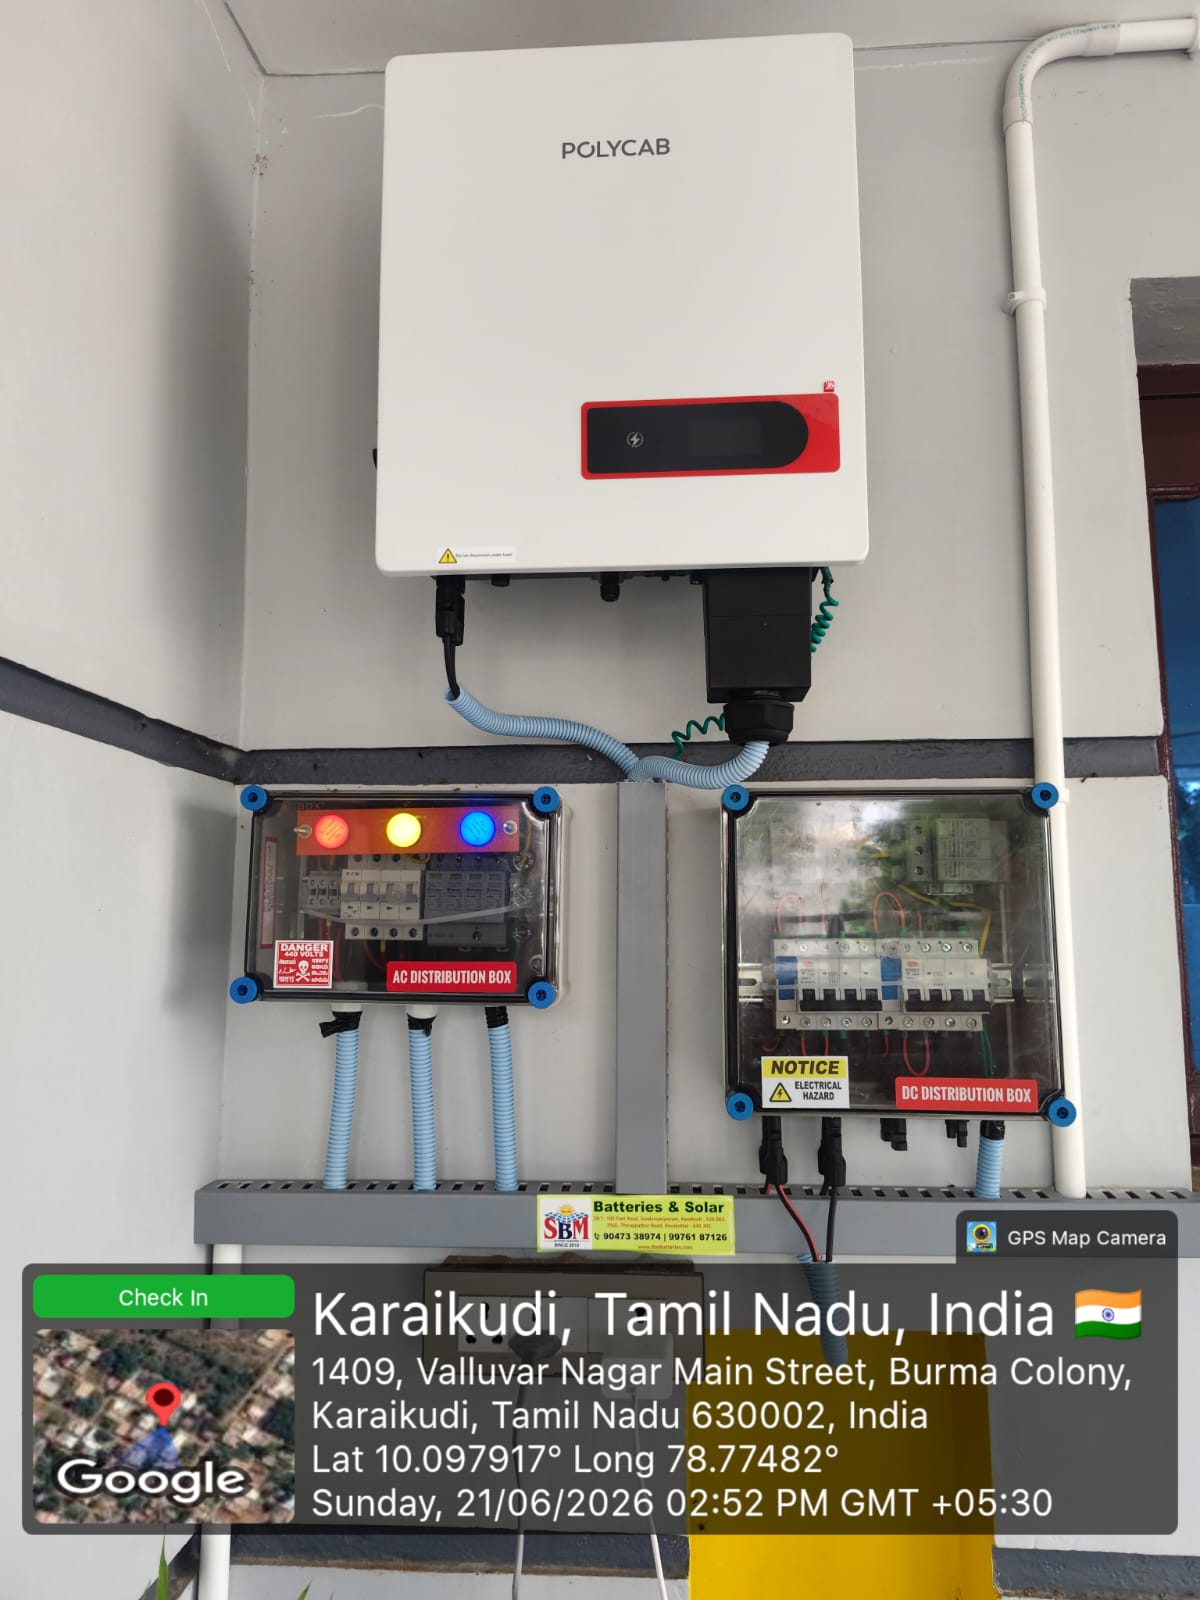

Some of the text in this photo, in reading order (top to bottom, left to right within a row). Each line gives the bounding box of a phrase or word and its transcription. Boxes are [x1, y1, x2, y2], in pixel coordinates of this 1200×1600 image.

[562, 138, 670, 159] POLYCAB
[280, 943, 329, 951] DANGER
[392, 970, 512, 984] AC DISTRIBUTION BOX
[771, 1060, 840, 1075] NOTICE
[794, 1081, 842, 1091] ELECTRICAL
[802, 1091, 835, 1101] HAZARD
[902, 1085, 1032, 1103] DC DISTRIBUTION BOX
[593, 1201, 725, 1214] Batteries & Solar
[544, 1214, 589, 1240] SBM
[603, 1232, 631, 1240] 90473
[633, 1232, 661, 1241] 38974
[668, 1233, 696, 1241] 99761
[699, 1233, 727, 1241] 87126
